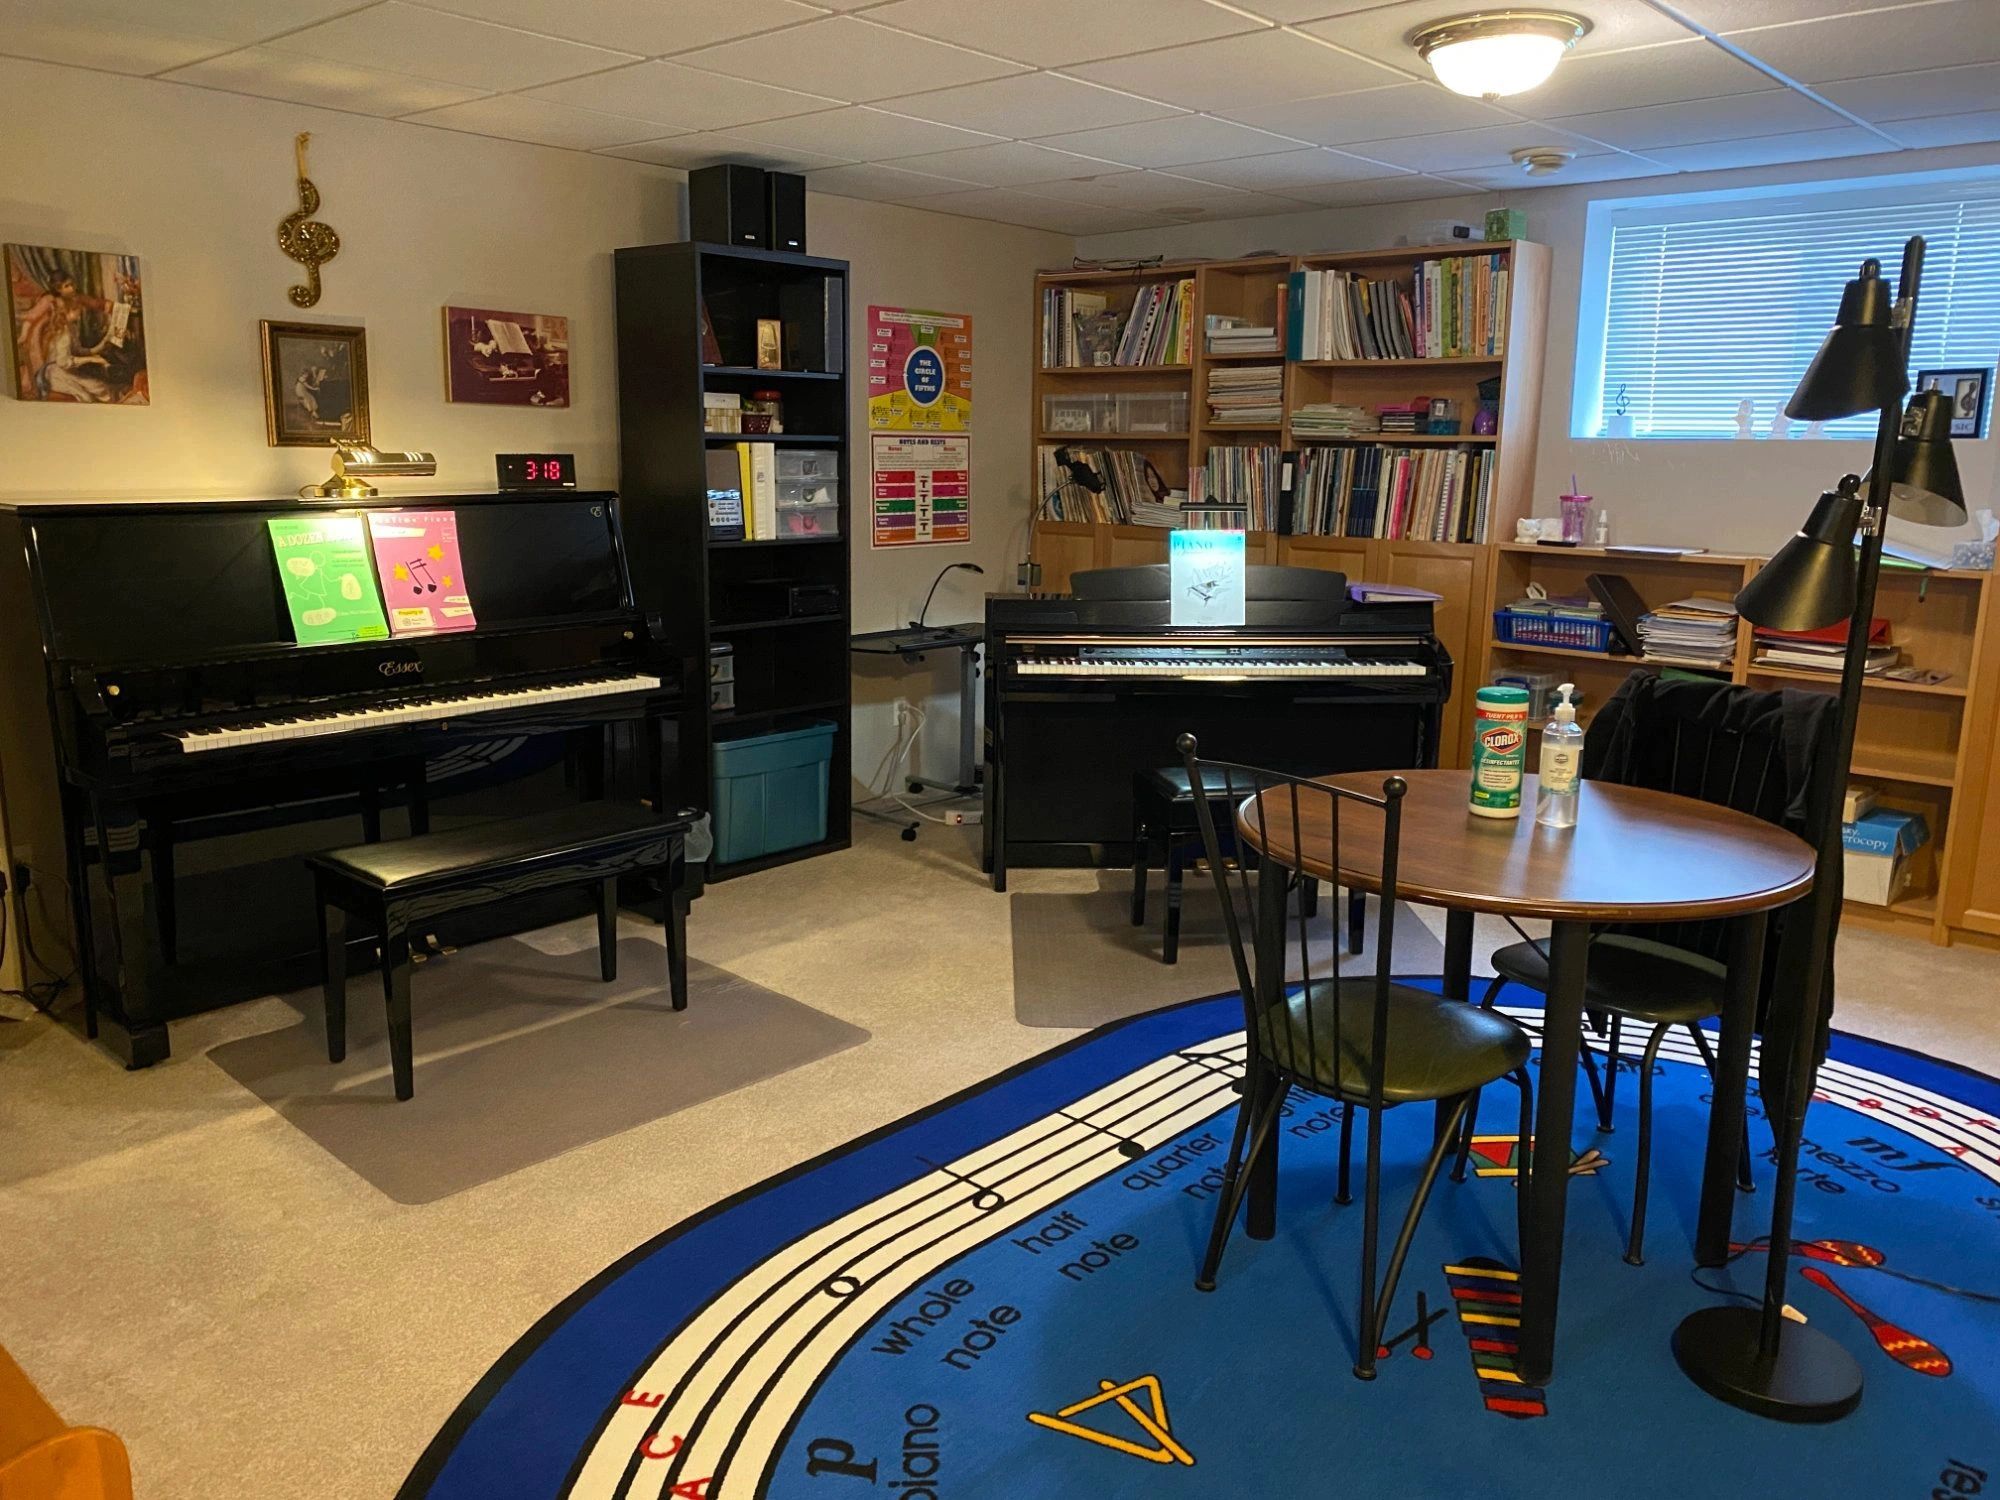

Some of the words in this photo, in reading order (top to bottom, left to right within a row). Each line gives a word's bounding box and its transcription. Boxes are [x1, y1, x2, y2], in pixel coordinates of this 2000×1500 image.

[526, 461, 560, 480] 3:18
[379, 661, 424, 677] Essex
[1484, 731, 1520, 748] CLOROX
[1122, 1132, 1225, 1191] quarter
[1011, 1210, 1088, 1254] half
[1058, 1233, 1140, 1281] note
[871, 1277, 975, 1355] whole
[940, 1304, 1022, 1370] note
[622, 1390, 665, 1408] E
[640, 1432, 683, 1460] C
[806, 1437, 878, 1485] p
